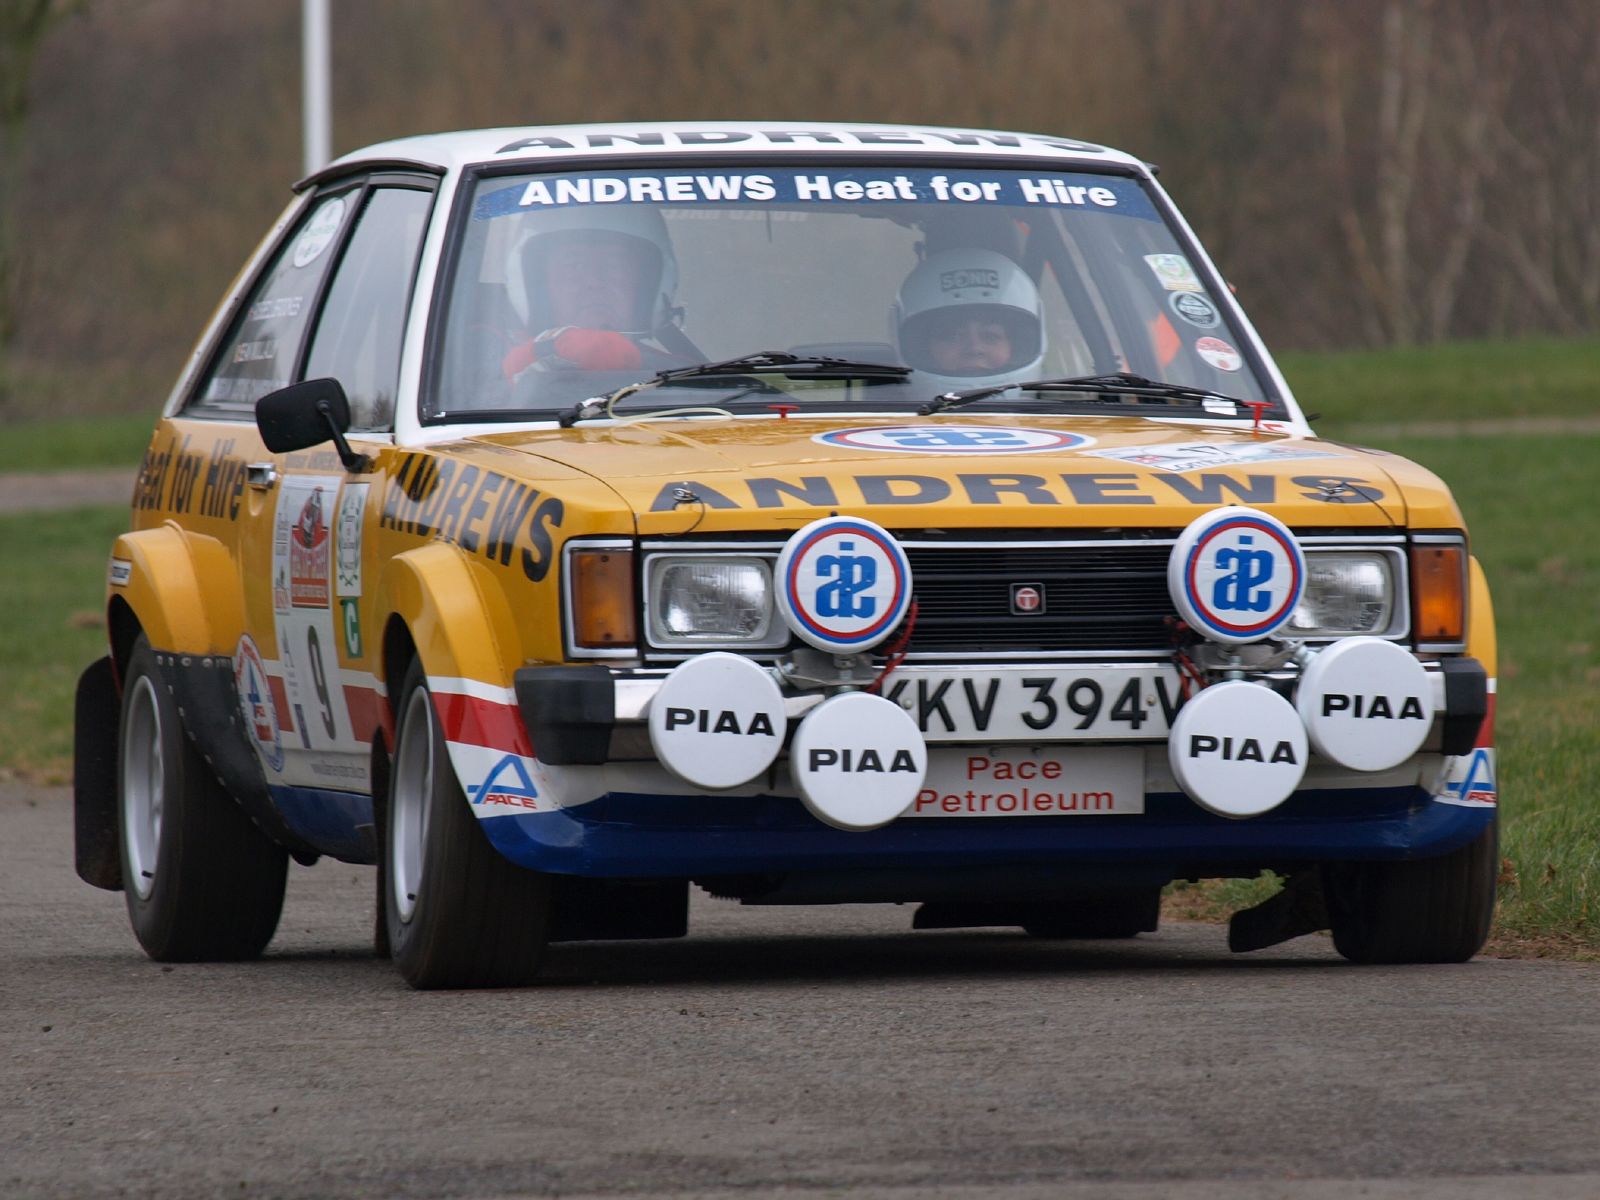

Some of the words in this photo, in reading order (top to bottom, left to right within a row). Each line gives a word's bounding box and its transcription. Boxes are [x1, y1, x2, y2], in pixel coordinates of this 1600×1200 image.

[495, 131, 1105, 154] ANDREWS
[519, 174, 777, 206] ANDREWS
[794, 175, 917, 201] Heat
[930, 175, 1001, 202] for
[1017, 178, 1118, 207] Hire
[942, 270, 999, 289] SONIC
[168, 433, 204, 514] for
[200, 438, 247, 521] Hire
[649, 473, 1385, 512] ANDREWS
[380, 452, 565, 583] ANDREWS
[344, 601, 358, 655] C
[307, 624, 337, 741] 9
[665, 707, 776, 737] PIAA
[1320, 693, 1426, 721] PIAA
[809, 748, 919, 773] PIAA
[1189, 734, 1298, 766] PIAA
[966, 757, 1063, 780] Pace
[483, 794, 537, 810] PACE
[914, 788, 1115, 813] Petroleum
